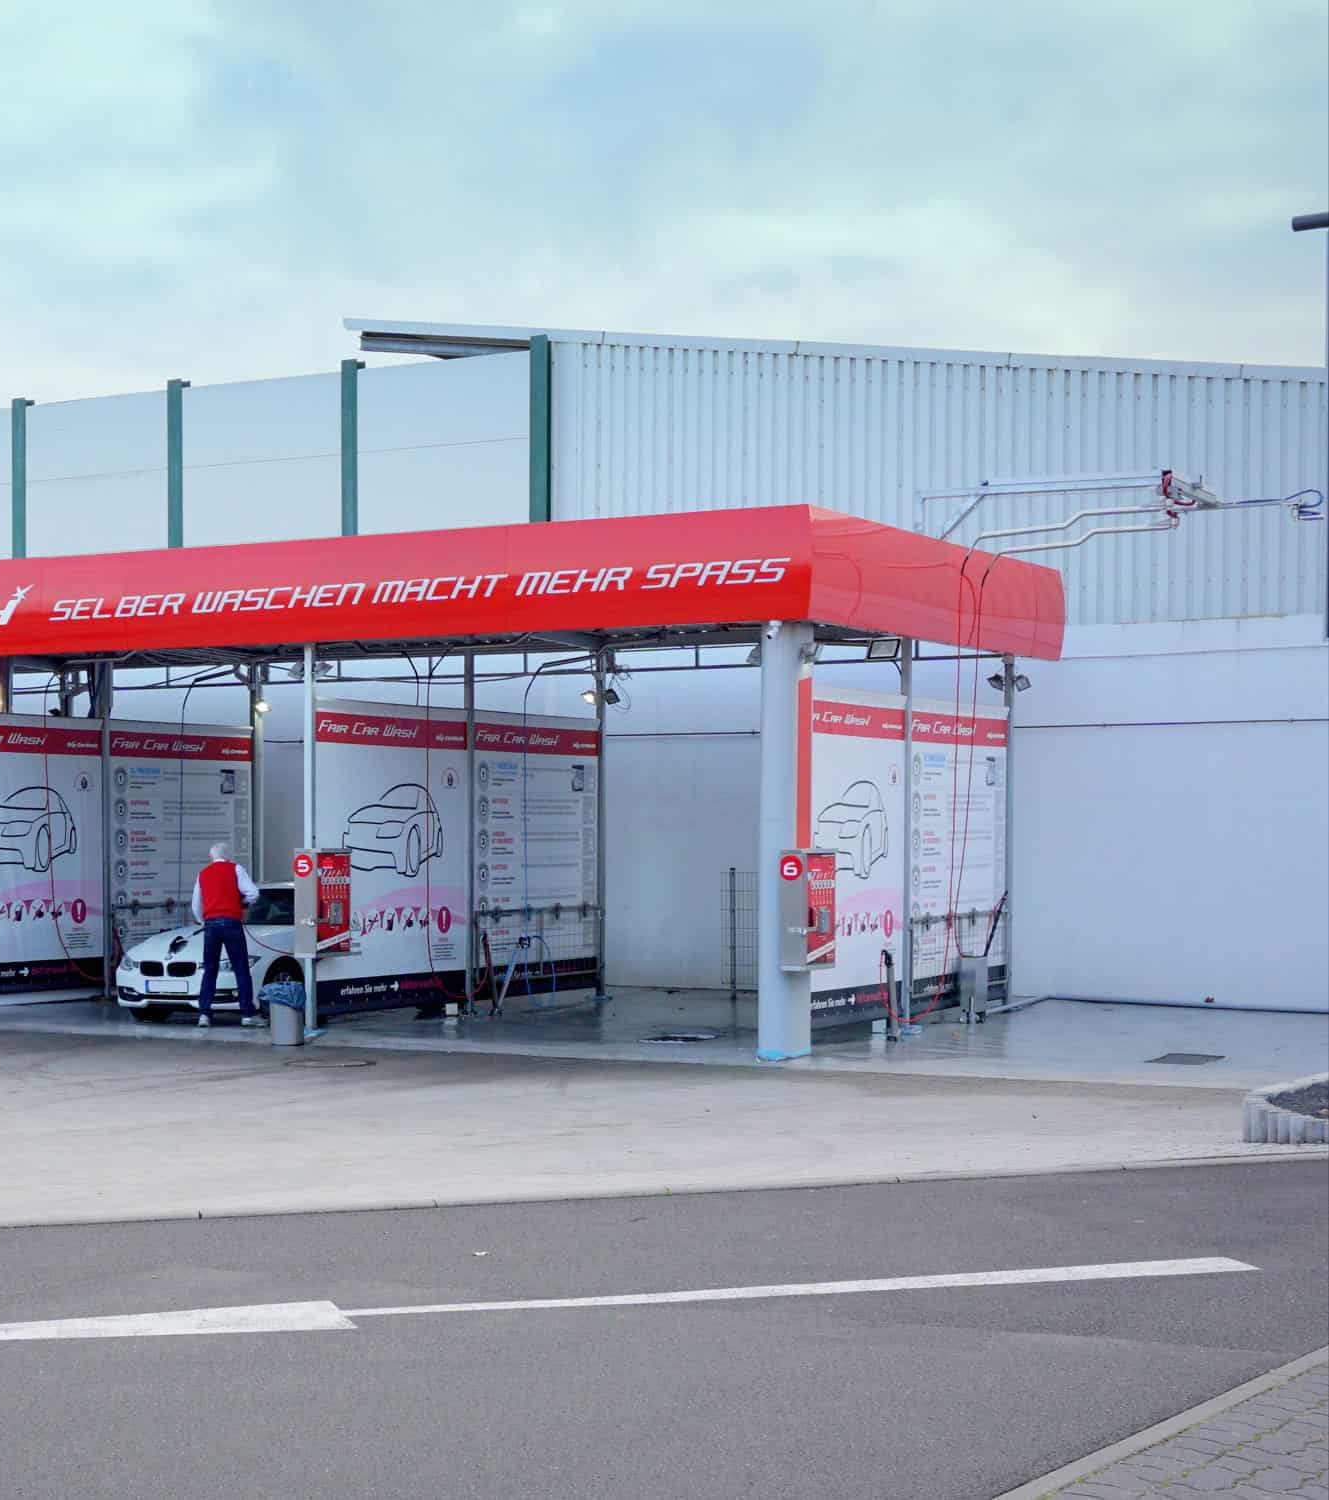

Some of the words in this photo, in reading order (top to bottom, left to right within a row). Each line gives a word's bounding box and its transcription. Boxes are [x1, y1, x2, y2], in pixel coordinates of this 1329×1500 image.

[49, 593, 186, 621] SELBER
[192, 583, 365, 614] WASCHEN
[372, 574, 508, 604] MACHT
[515, 567, 633, 596] MEHR
[641, 557, 792, 590] SPASS
[297, 860, 309, 873] 5
[783, 862, 798, 877] 6
